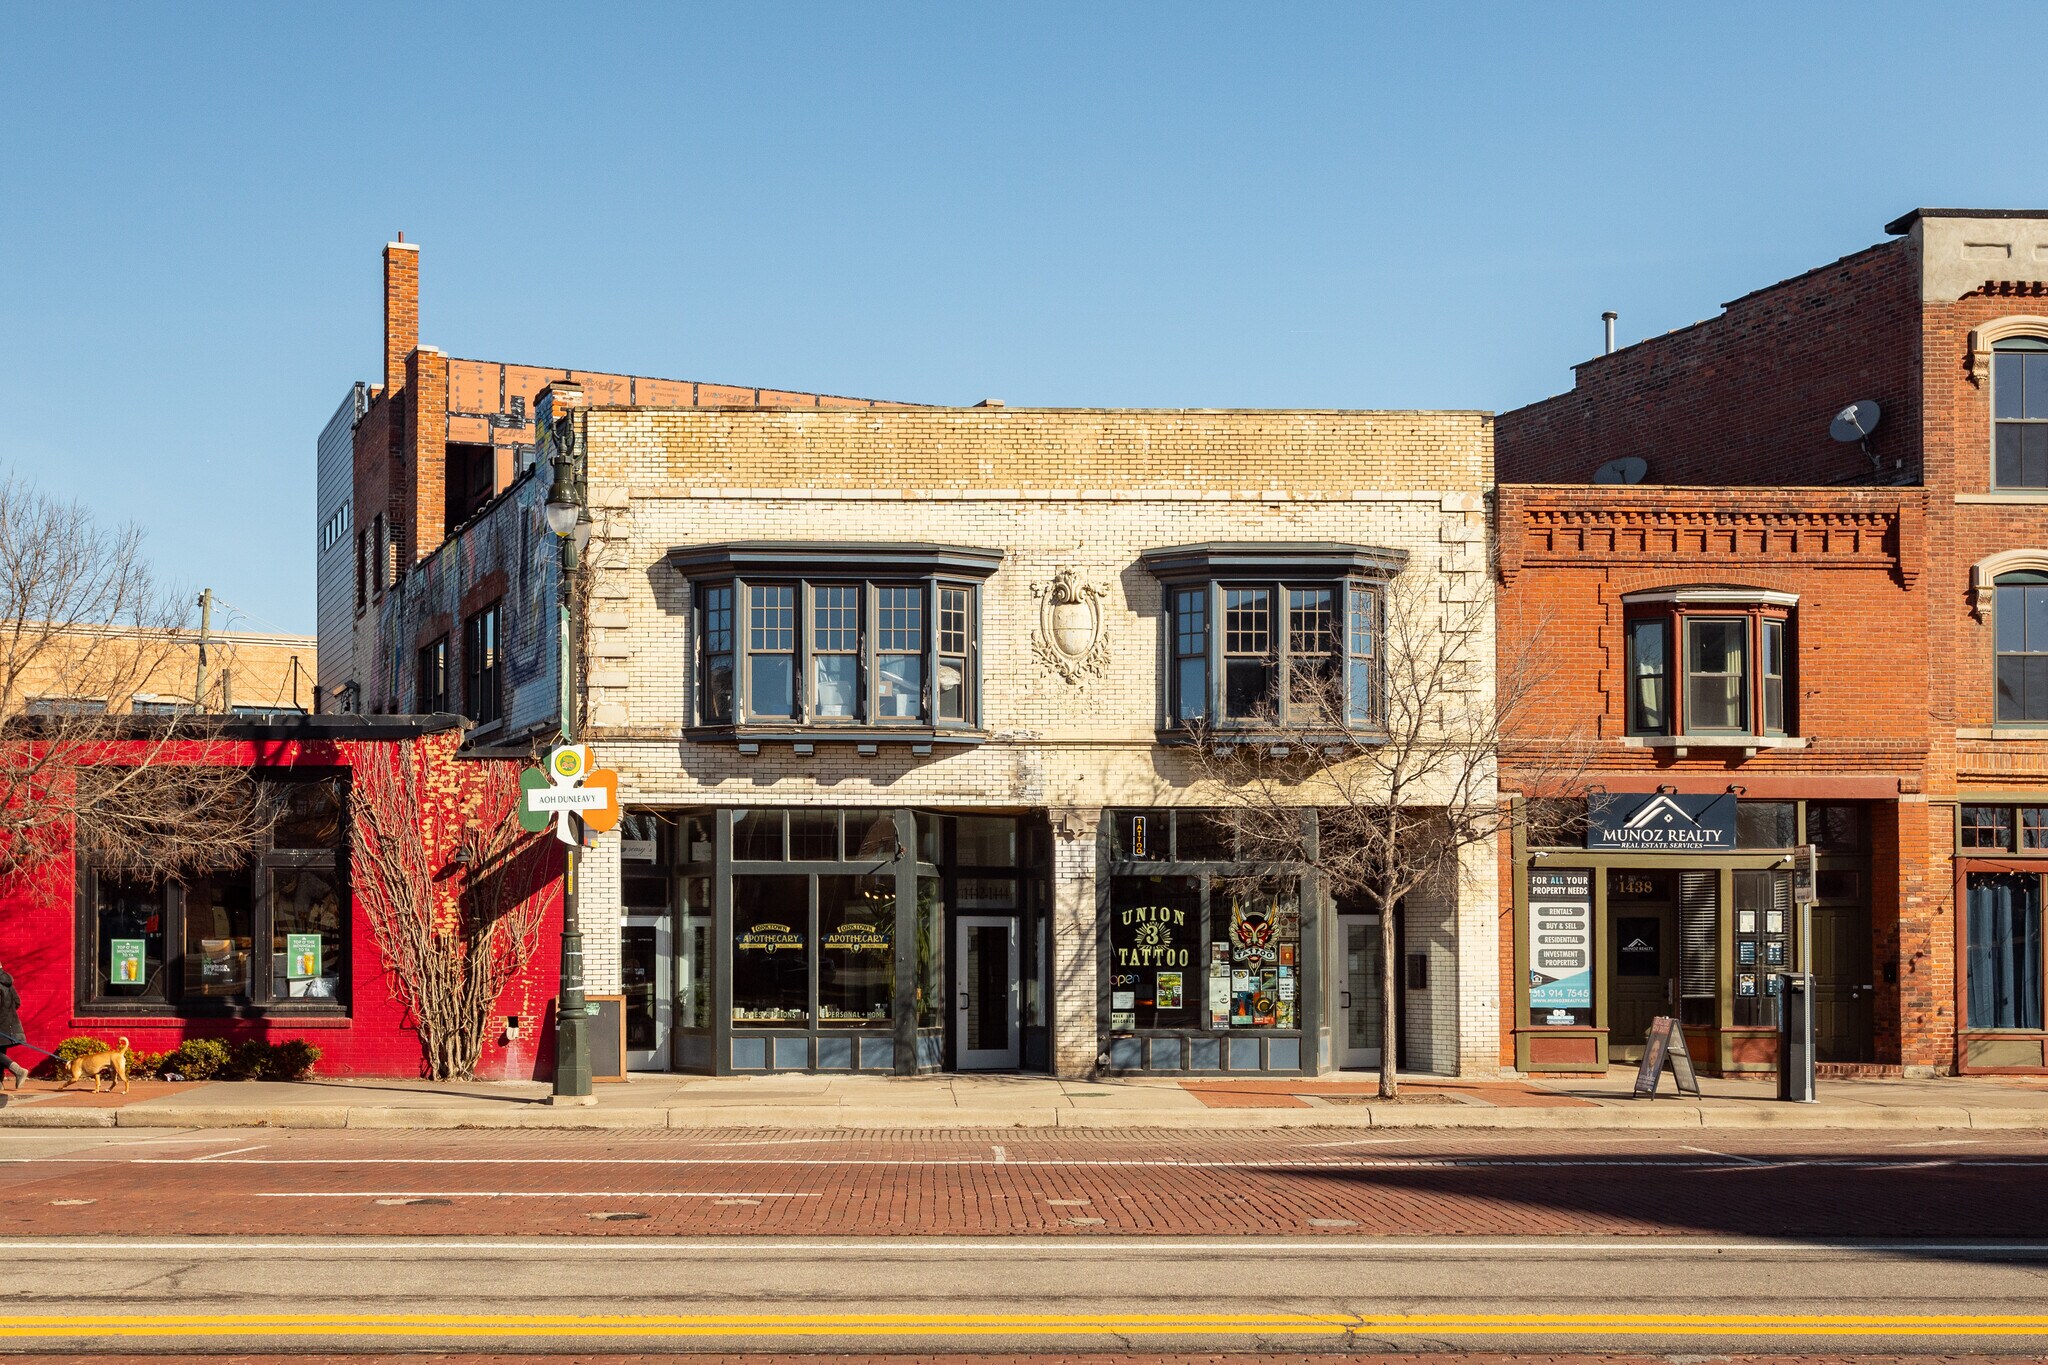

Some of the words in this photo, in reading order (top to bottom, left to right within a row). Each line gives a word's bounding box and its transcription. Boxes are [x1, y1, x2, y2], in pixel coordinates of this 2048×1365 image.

[539, 796, 556, 804] AOH
[558, 794, 596, 804] DUNLEAVY
[1602, 830, 1664, 842] MUNOZ
[1668, 830, 1723, 842] REALTY
[1532, 876, 1547, 884] FOR
[1550, 876, 1564, 884] ALL
[1566, 876, 1588, 884] YOUR
[1532, 886, 1566, 894] PROPERTY
[1568, 886, 1588, 894] NEEDS
[1620, 880, 1652, 893] 1438
[1122, 906, 1185, 926] UNION
[743, 934, 799, 942] APOTHECARY
[828, 934, 884, 942] APOTHECARY
[1146, 925, 1159, 945] 3
[1118, 948, 1189, 967] TATTOO
[1236, 948, 1272, 958] TATTOO
[1110, 974, 1140, 987] open
